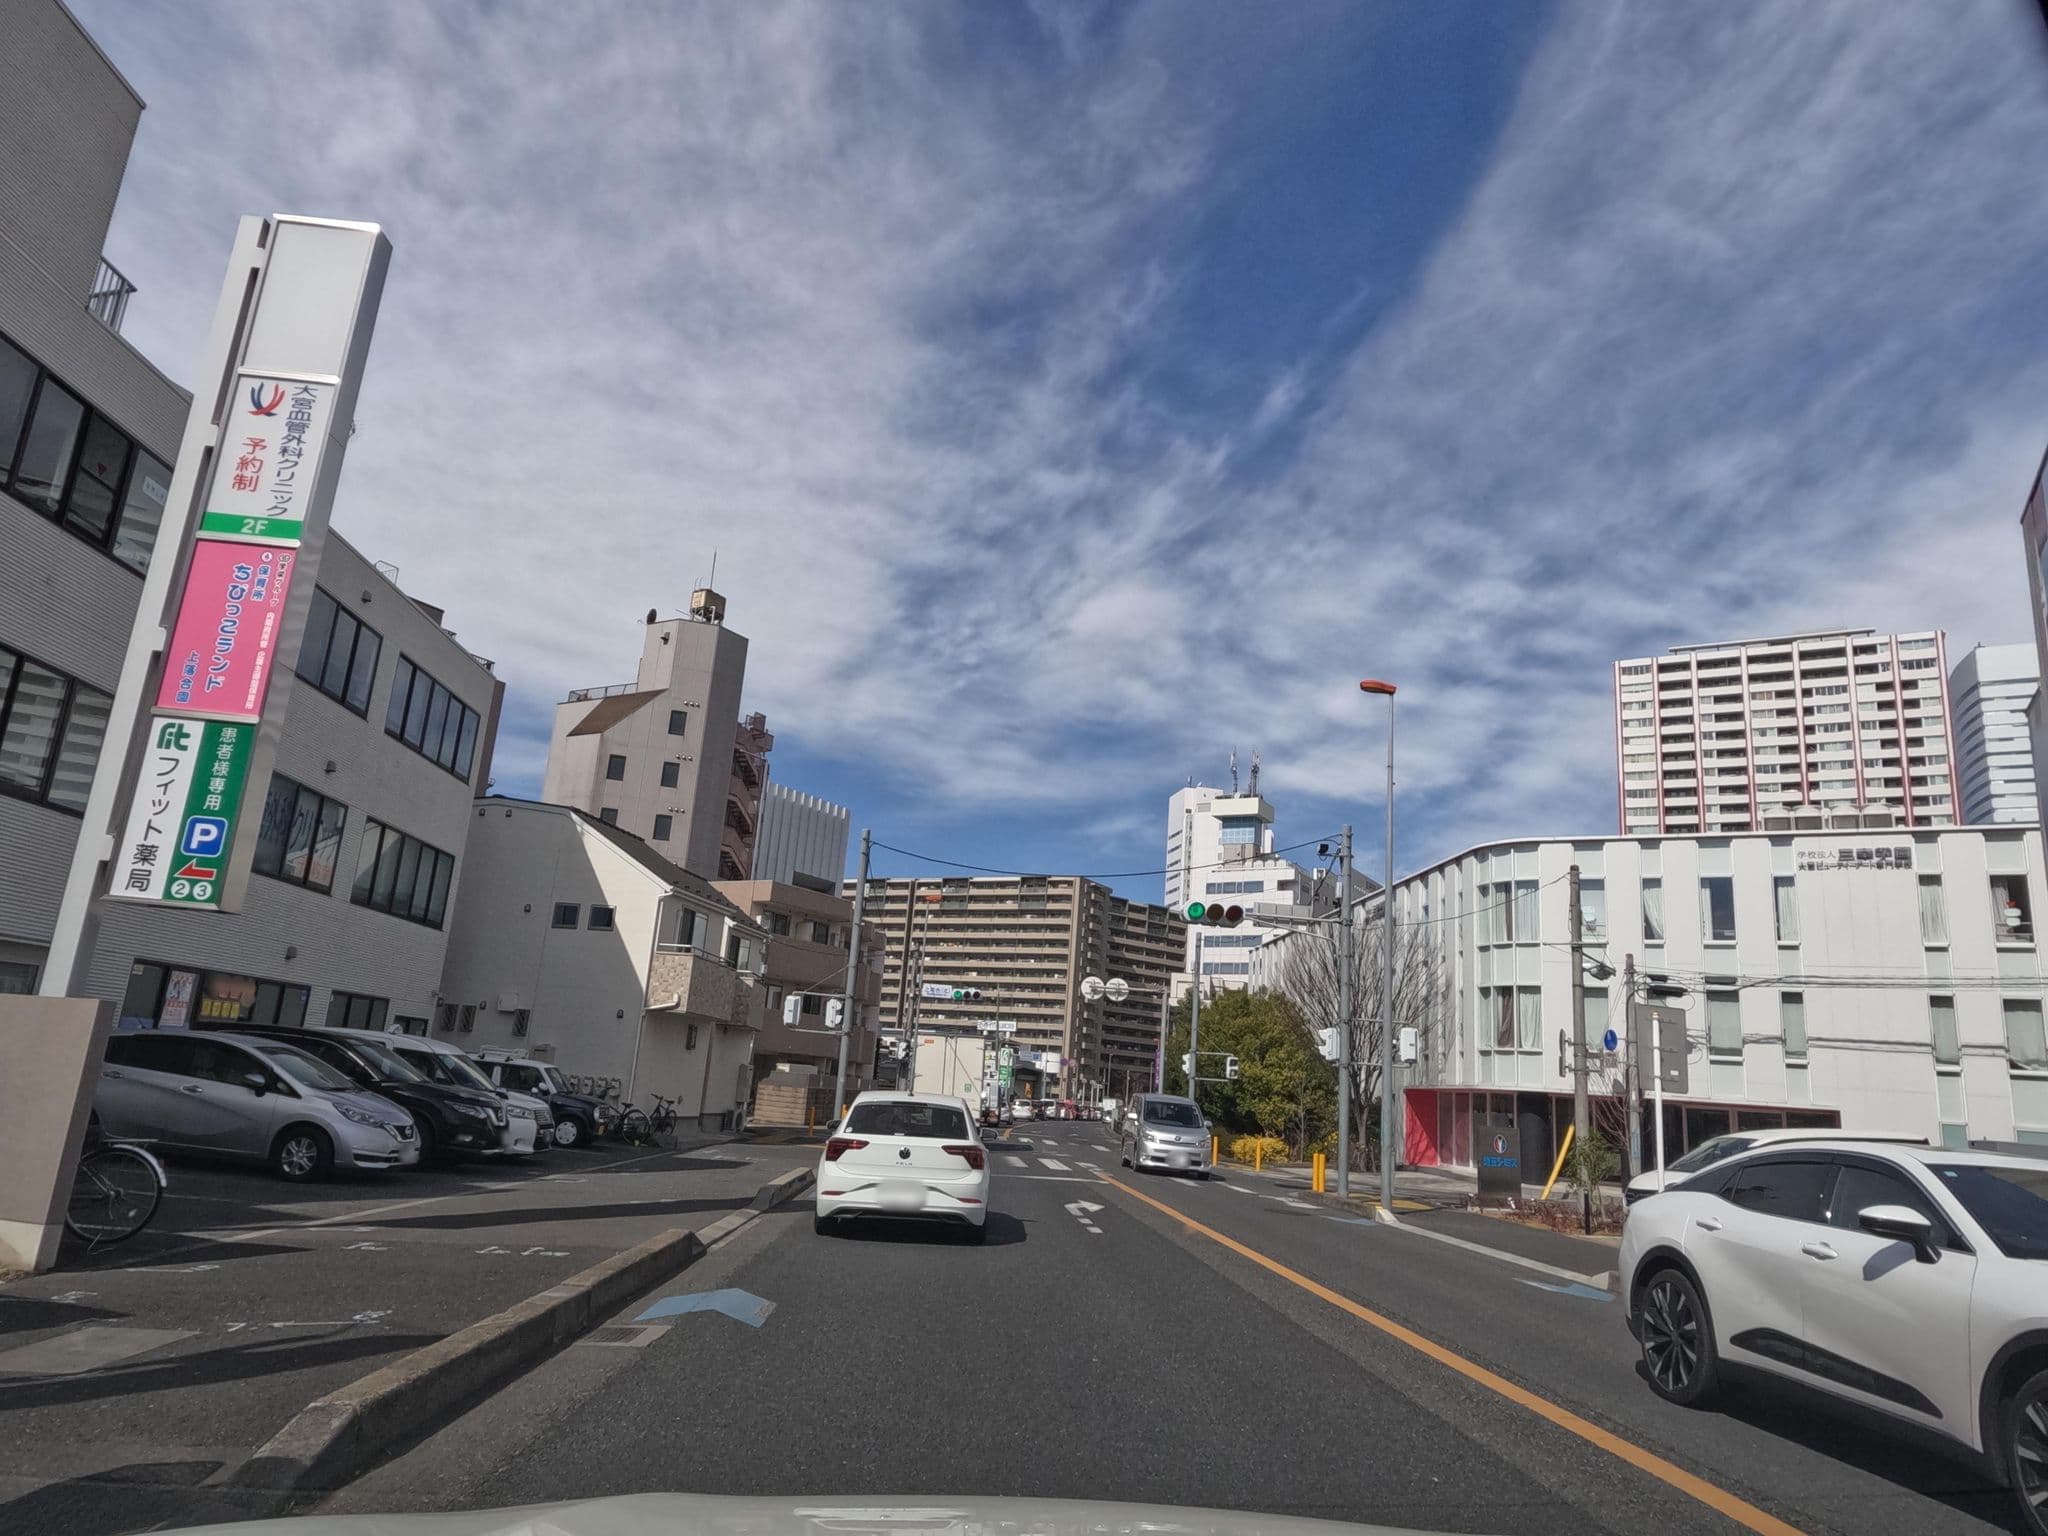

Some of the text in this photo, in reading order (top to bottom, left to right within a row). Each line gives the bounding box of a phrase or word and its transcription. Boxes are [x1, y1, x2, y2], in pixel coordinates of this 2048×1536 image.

[231, 437, 267, 492] 予約制
[266, 384, 318, 516] 大宮血管外科クリニック
[241, 519, 269, 535] 2F
[251, 565, 271, 601] 保育所
[205, 564, 253, 693] ちびっこランド
[203, 727, 238, 811] 患者様専用
[125, 756, 180, 893] フィット薬局
[189, 822, 219, 850] P
